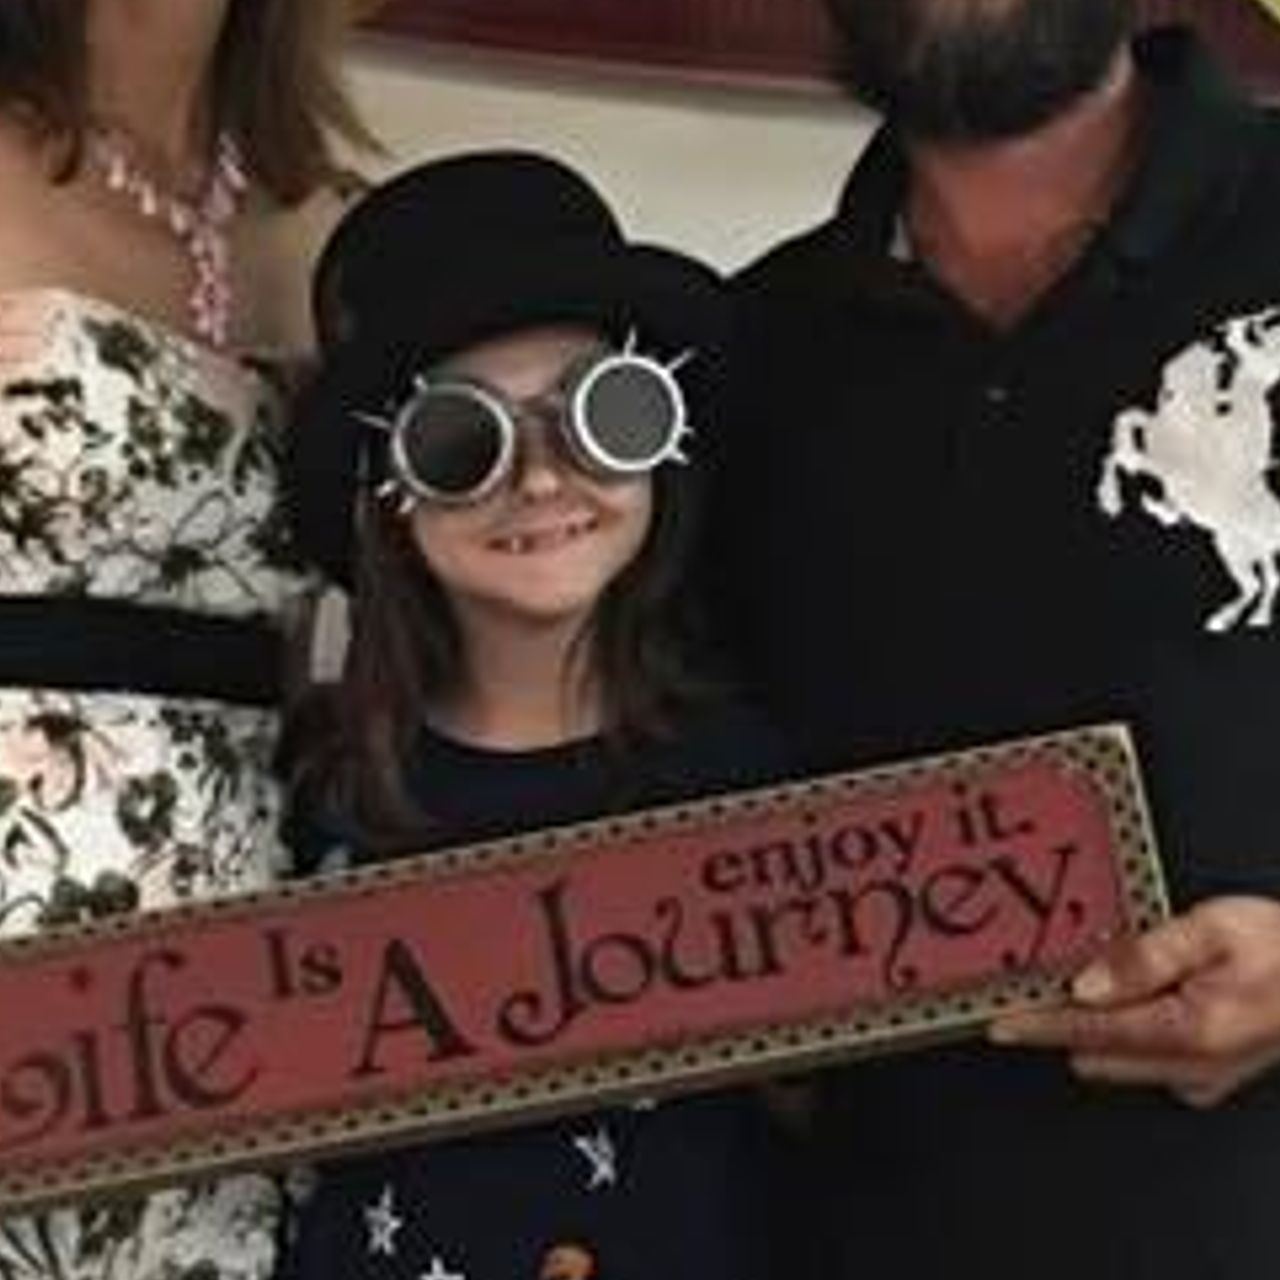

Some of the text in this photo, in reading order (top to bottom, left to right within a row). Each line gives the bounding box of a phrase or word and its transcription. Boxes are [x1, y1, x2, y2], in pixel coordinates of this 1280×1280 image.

[700, 780, 1034, 894] enjoy it.
[261, 927, 344, 1001] Is
[352, 937, 478, 1078] A
